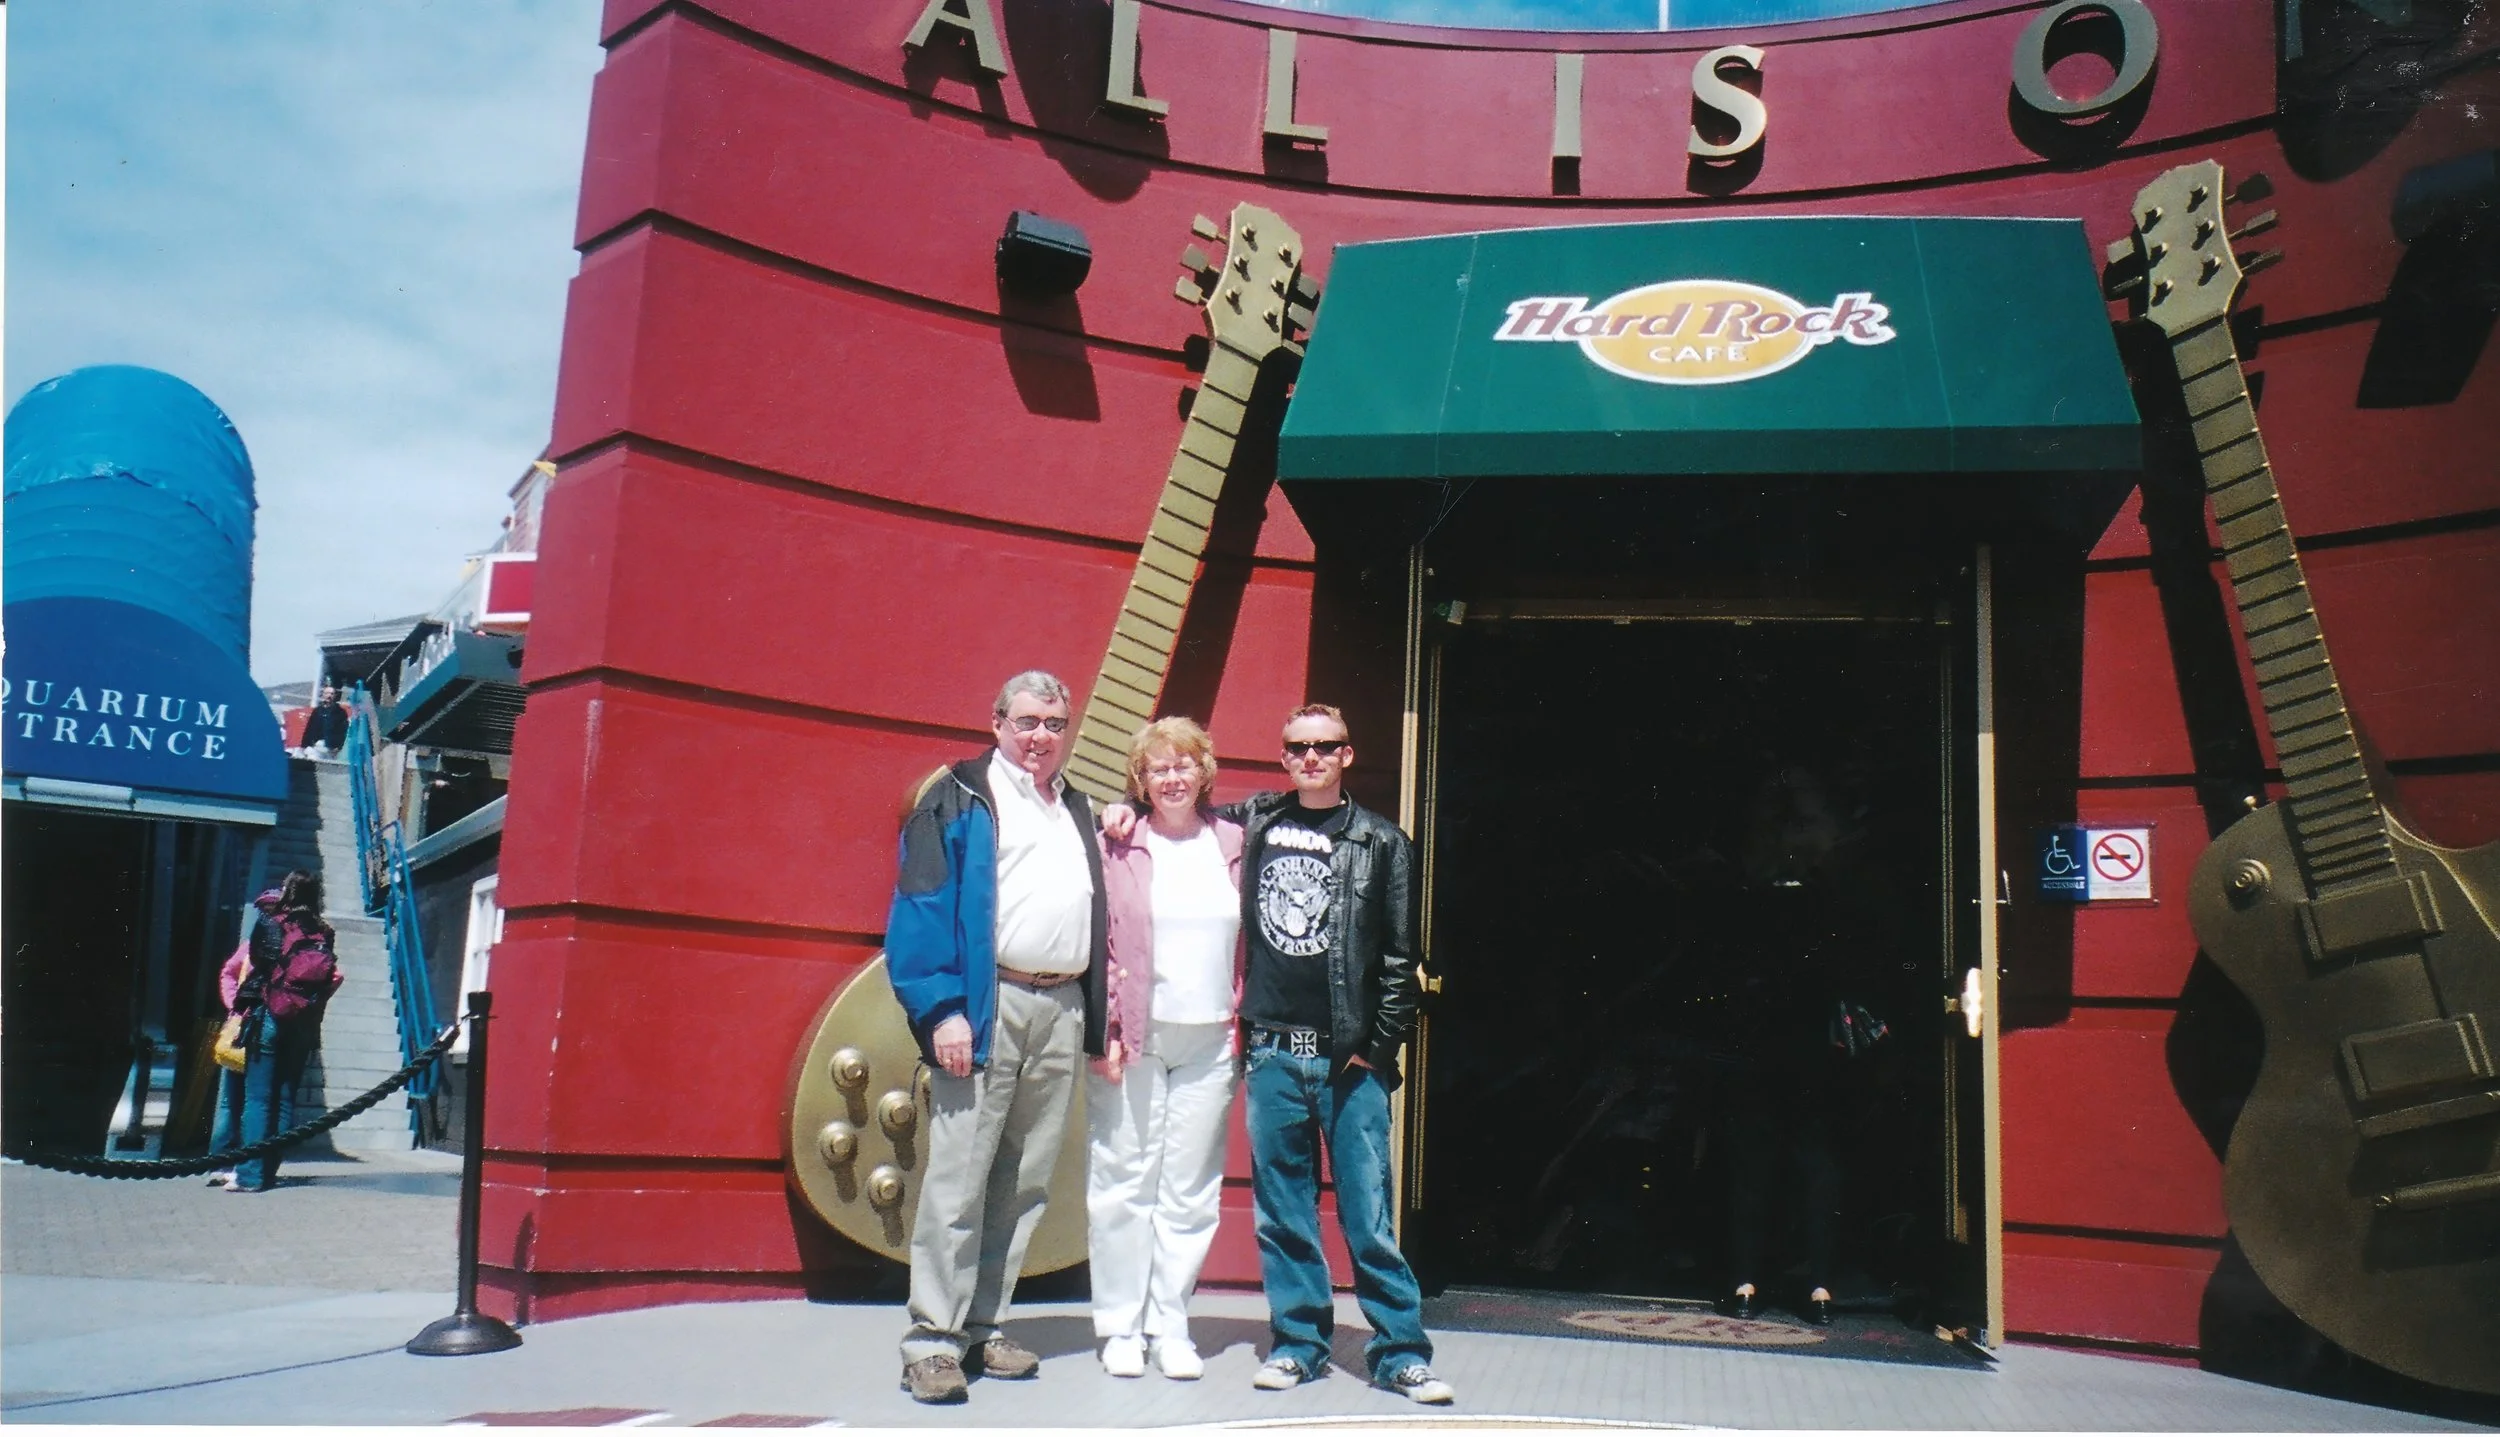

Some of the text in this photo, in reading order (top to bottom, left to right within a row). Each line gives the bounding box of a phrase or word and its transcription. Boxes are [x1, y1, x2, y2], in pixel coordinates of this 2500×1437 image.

[900, 0, 1328, 141] ALL
[1552, 45, 1768, 157] IS
[1494, 293, 1895, 345] Hard Rock
[2, 711, 227, 760] TRANCE
